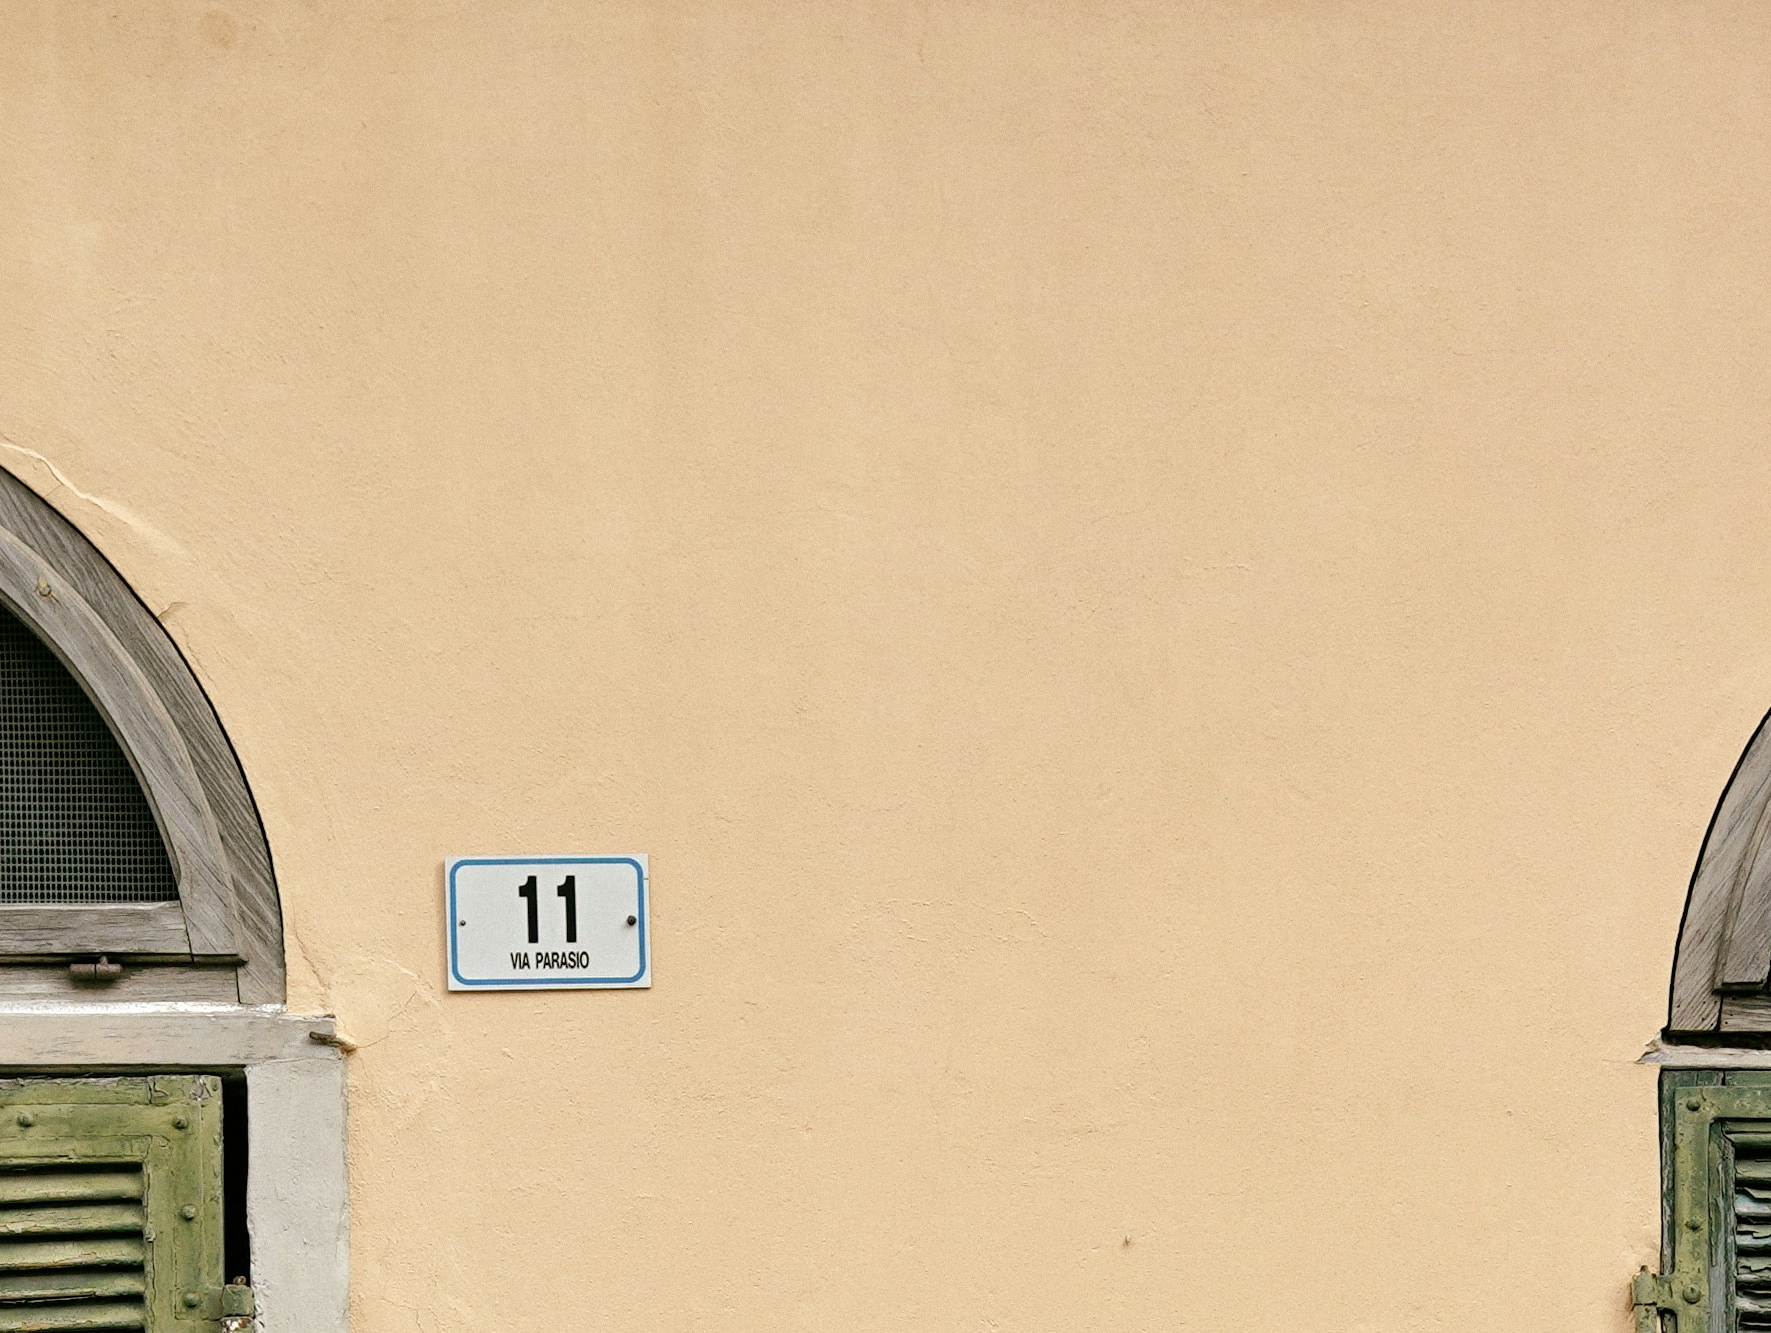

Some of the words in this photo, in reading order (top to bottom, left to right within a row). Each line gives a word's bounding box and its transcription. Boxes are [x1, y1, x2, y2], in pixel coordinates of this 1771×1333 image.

[518, 875, 577, 943] 11
[510, 952, 530, 970] VIA
[535, 951, 590, 969] PARASIO
